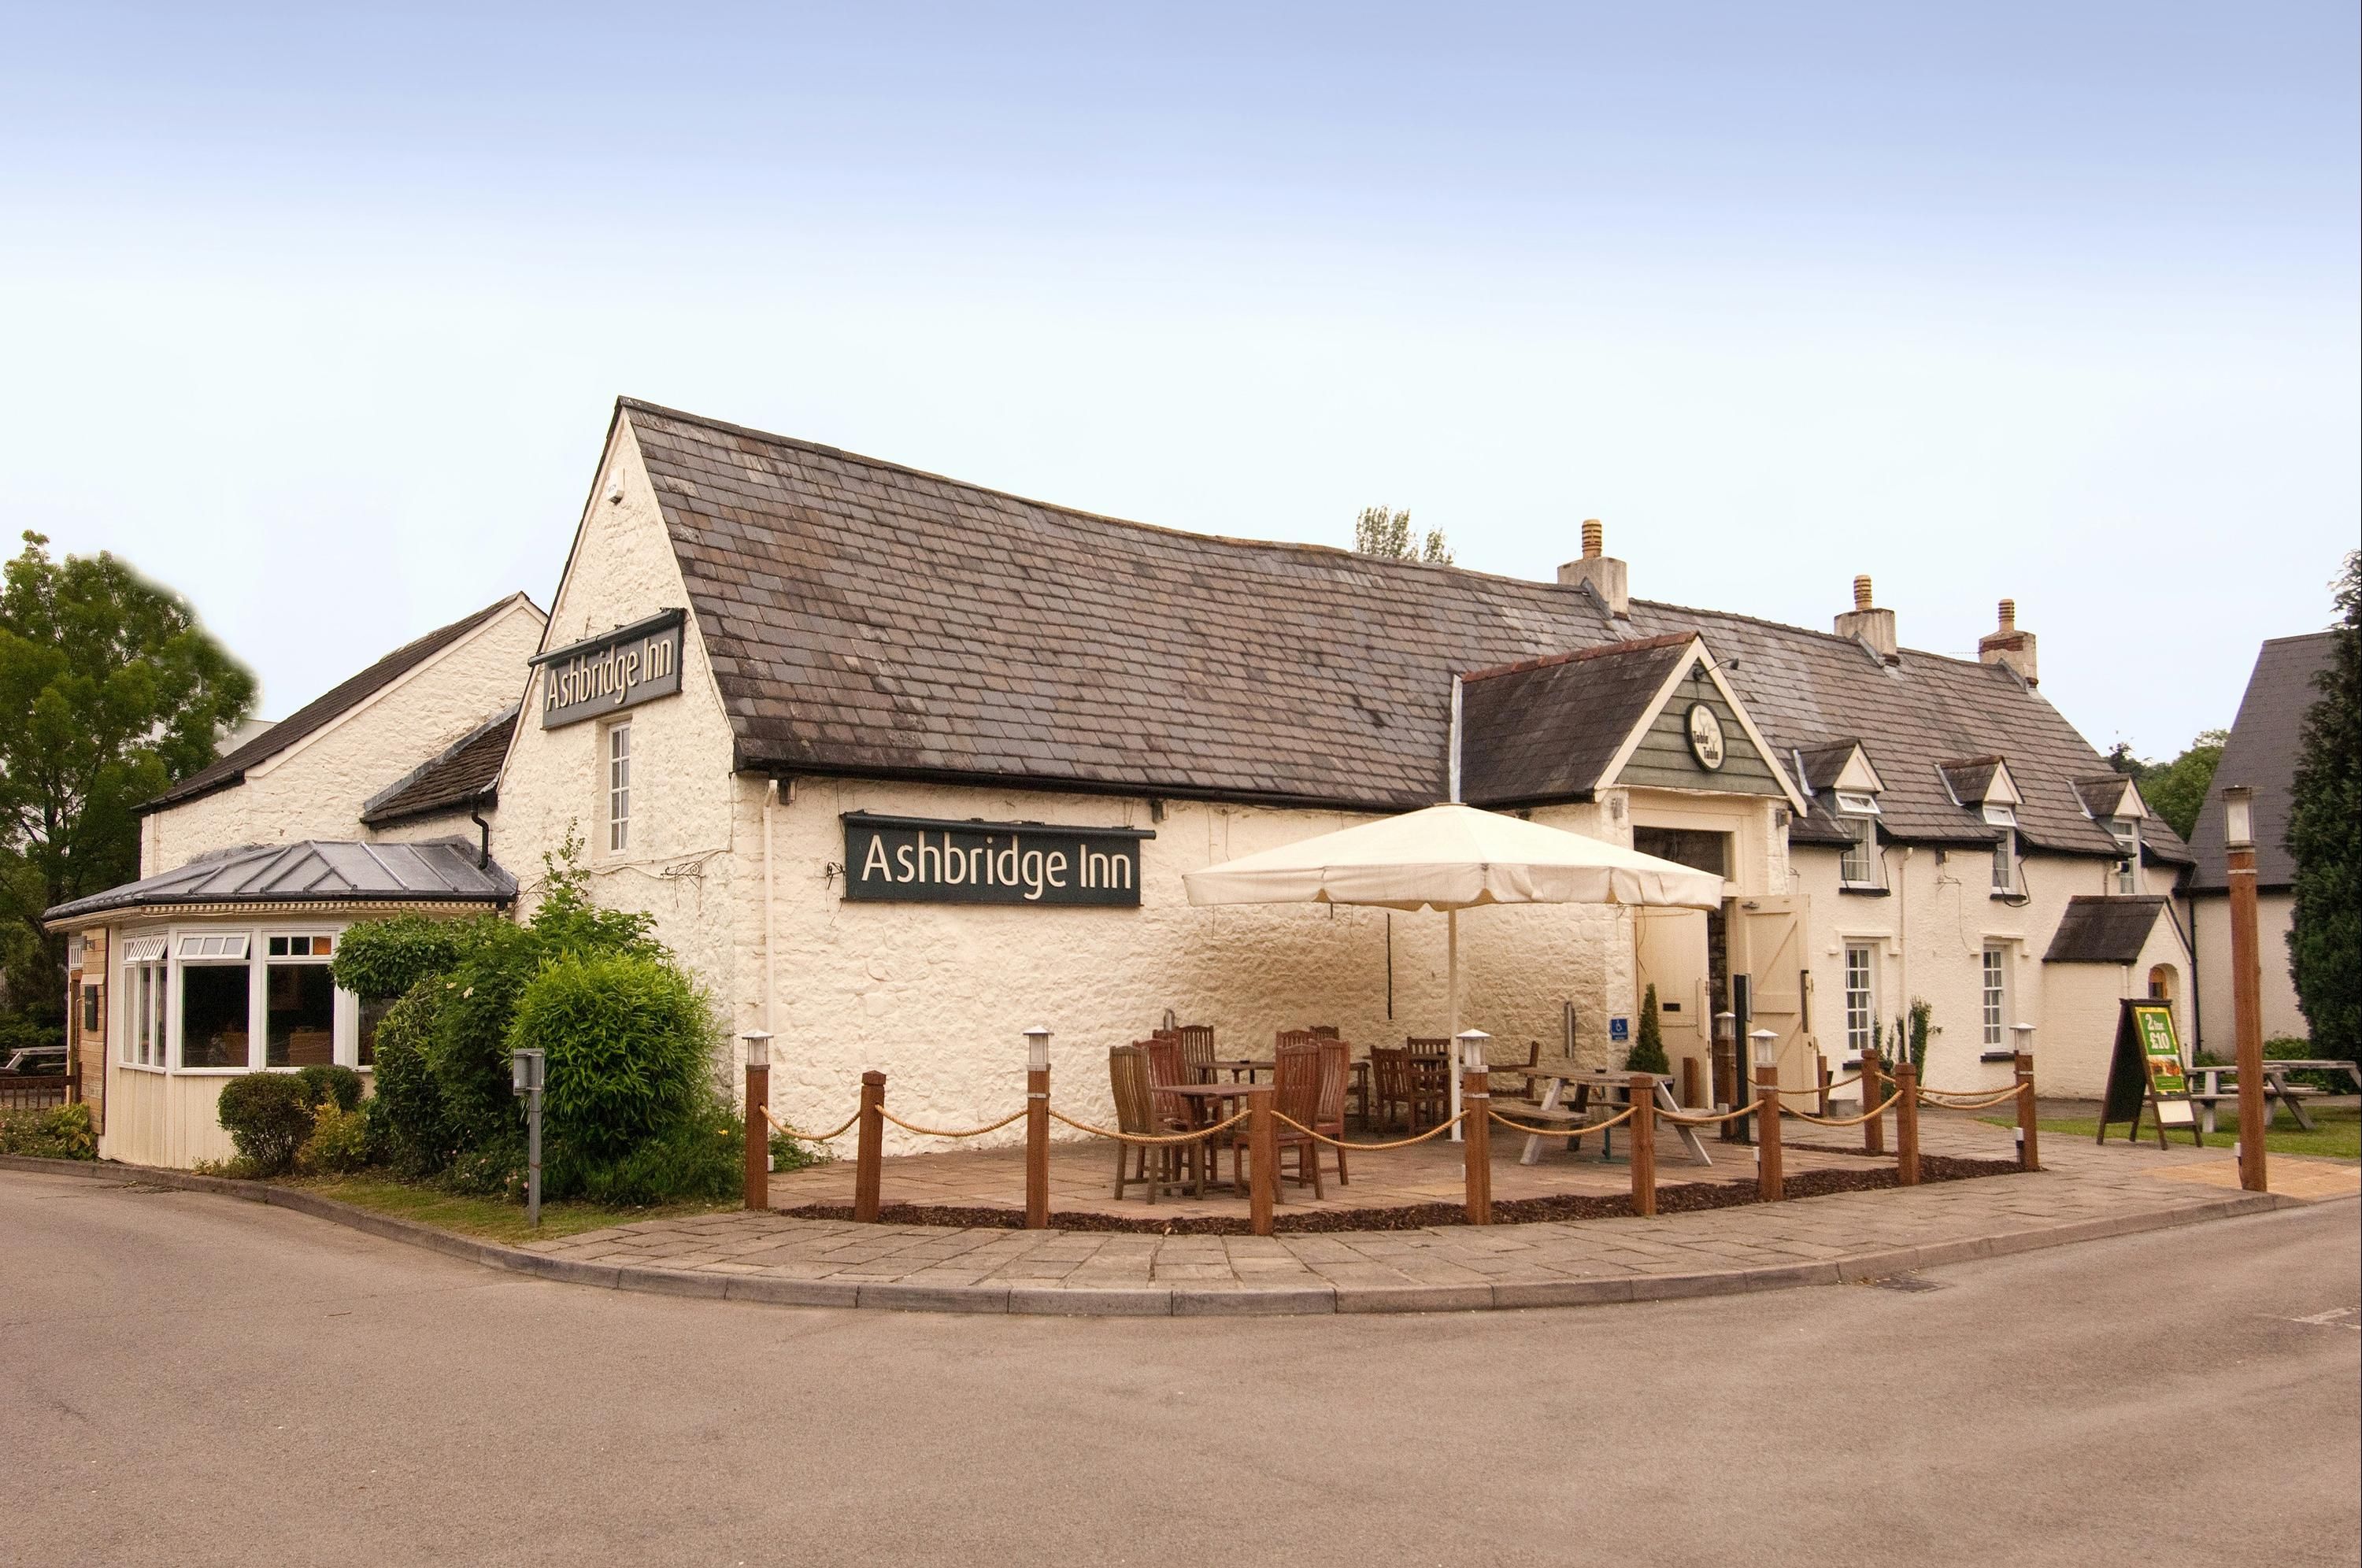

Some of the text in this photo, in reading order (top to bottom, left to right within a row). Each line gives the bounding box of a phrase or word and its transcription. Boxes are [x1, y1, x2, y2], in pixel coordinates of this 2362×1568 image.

[546, 638, 673, 712] Ashbridge Inn
[862, 831, 1131, 900] Ashbridge Inn
[2145, 1013, 2155, 1030] 2
[2149, 1032, 2171, 1049] £10
